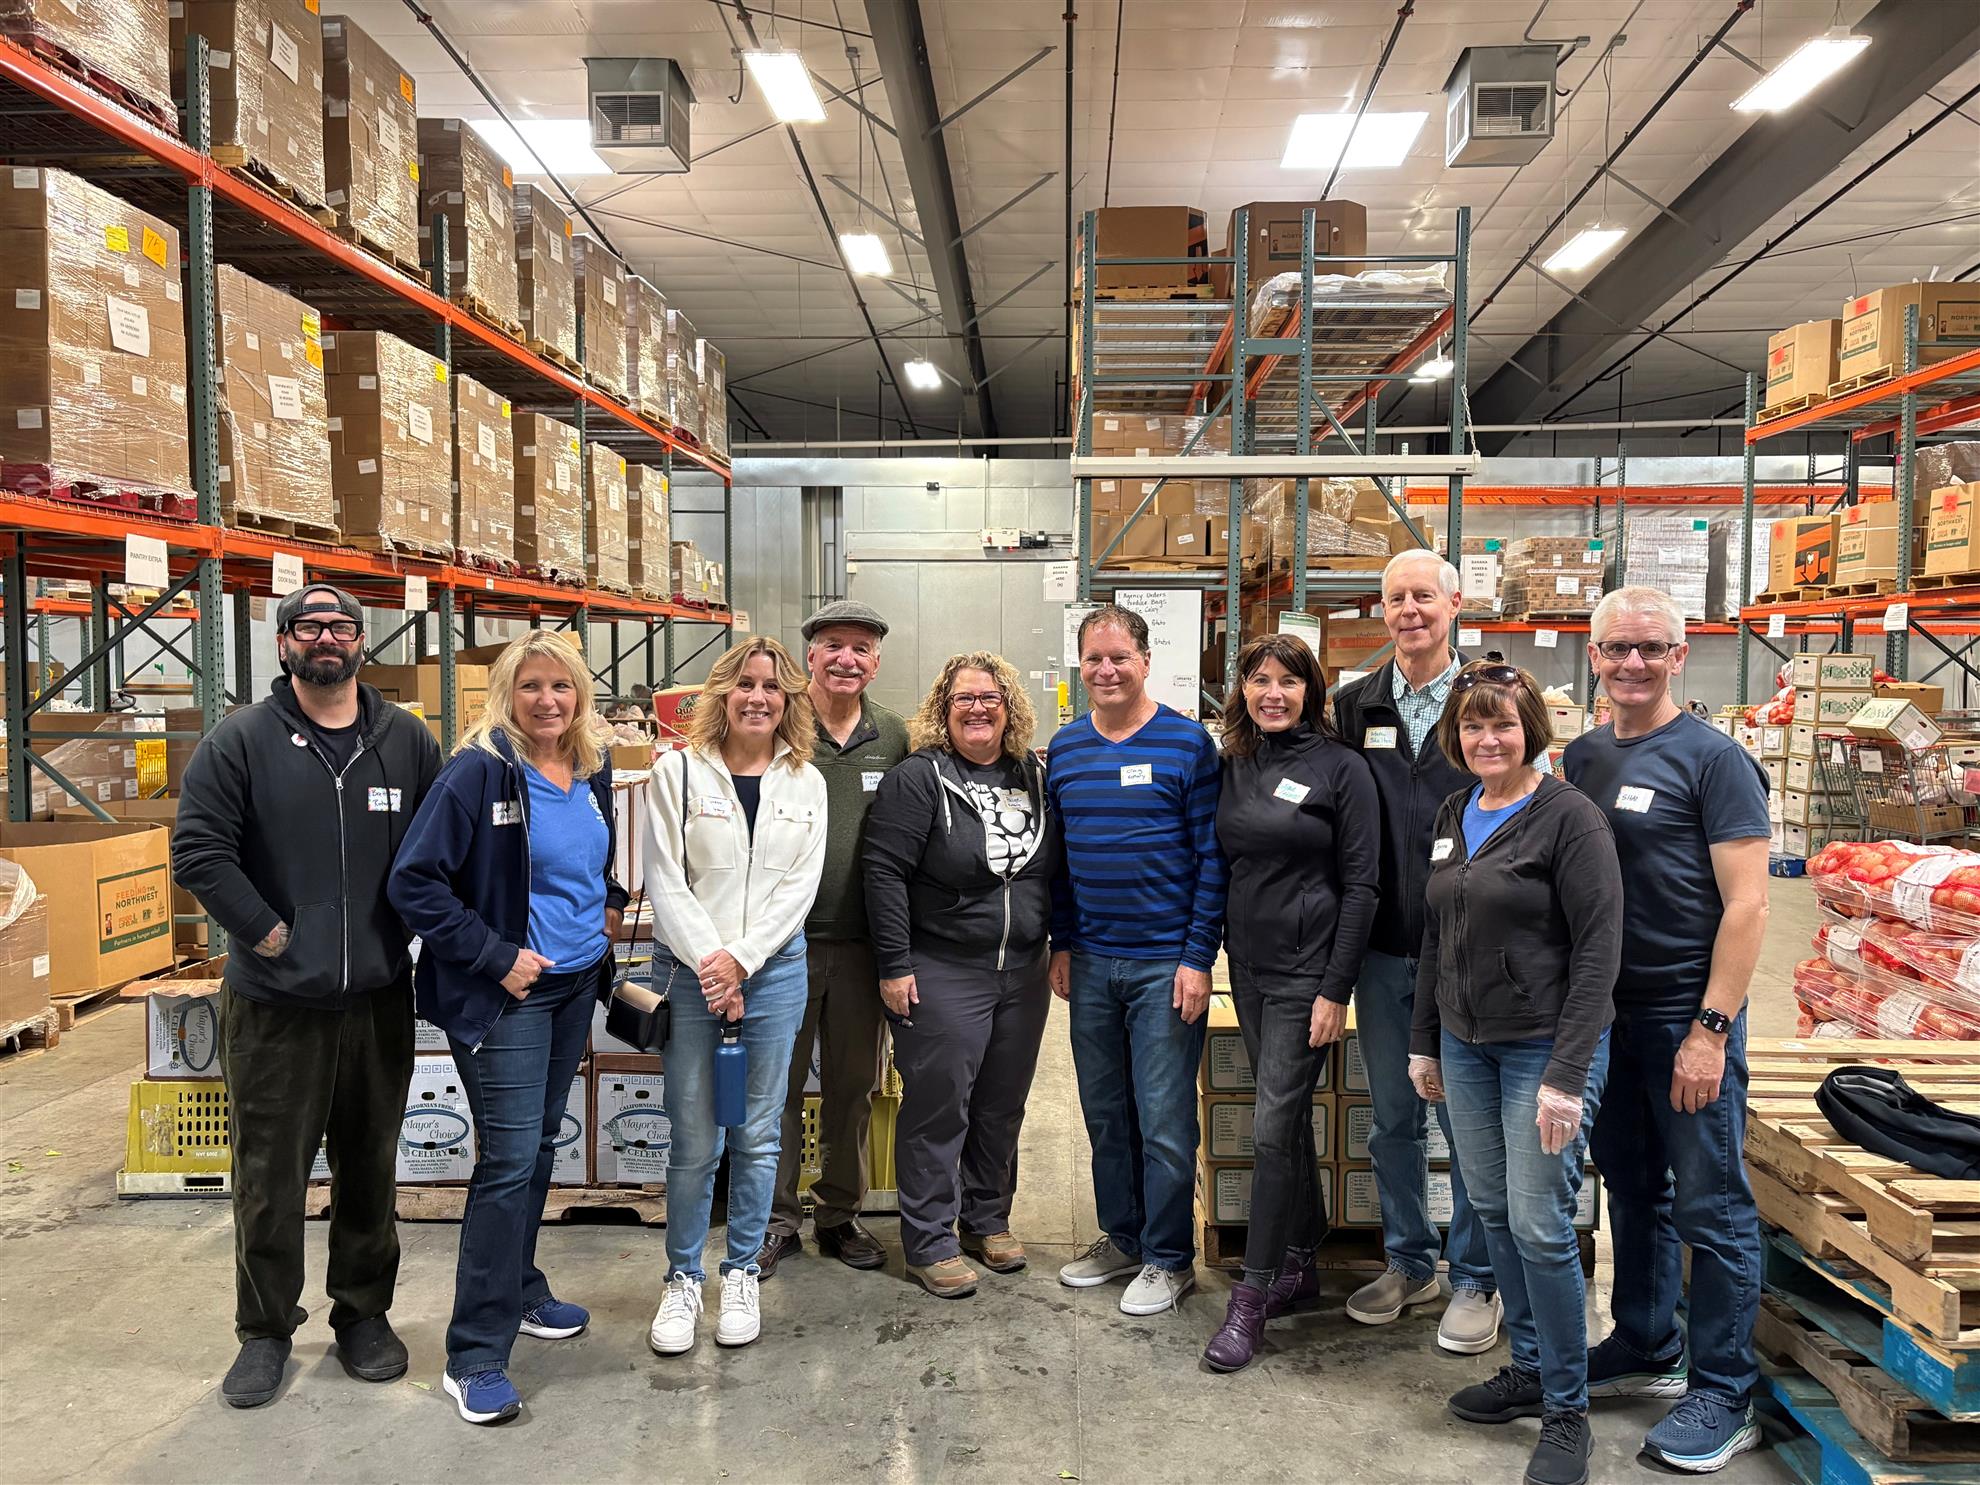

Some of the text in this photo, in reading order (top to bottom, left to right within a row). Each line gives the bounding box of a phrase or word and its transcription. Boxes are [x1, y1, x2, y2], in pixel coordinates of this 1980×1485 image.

[116, 891, 159, 910] NORTHWEST
[171, 1015, 179, 1052] CELERY
[403, 1119, 440, 1132] Mayor's
[621, 1118, 657, 1131] Mayor's
[429, 1128, 460, 1140] Choice
[647, 1129, 671, 1140] Choic
[411, 1149, 447, 1158] CELERY
[627, 1148, 664, 1158] CELERY
